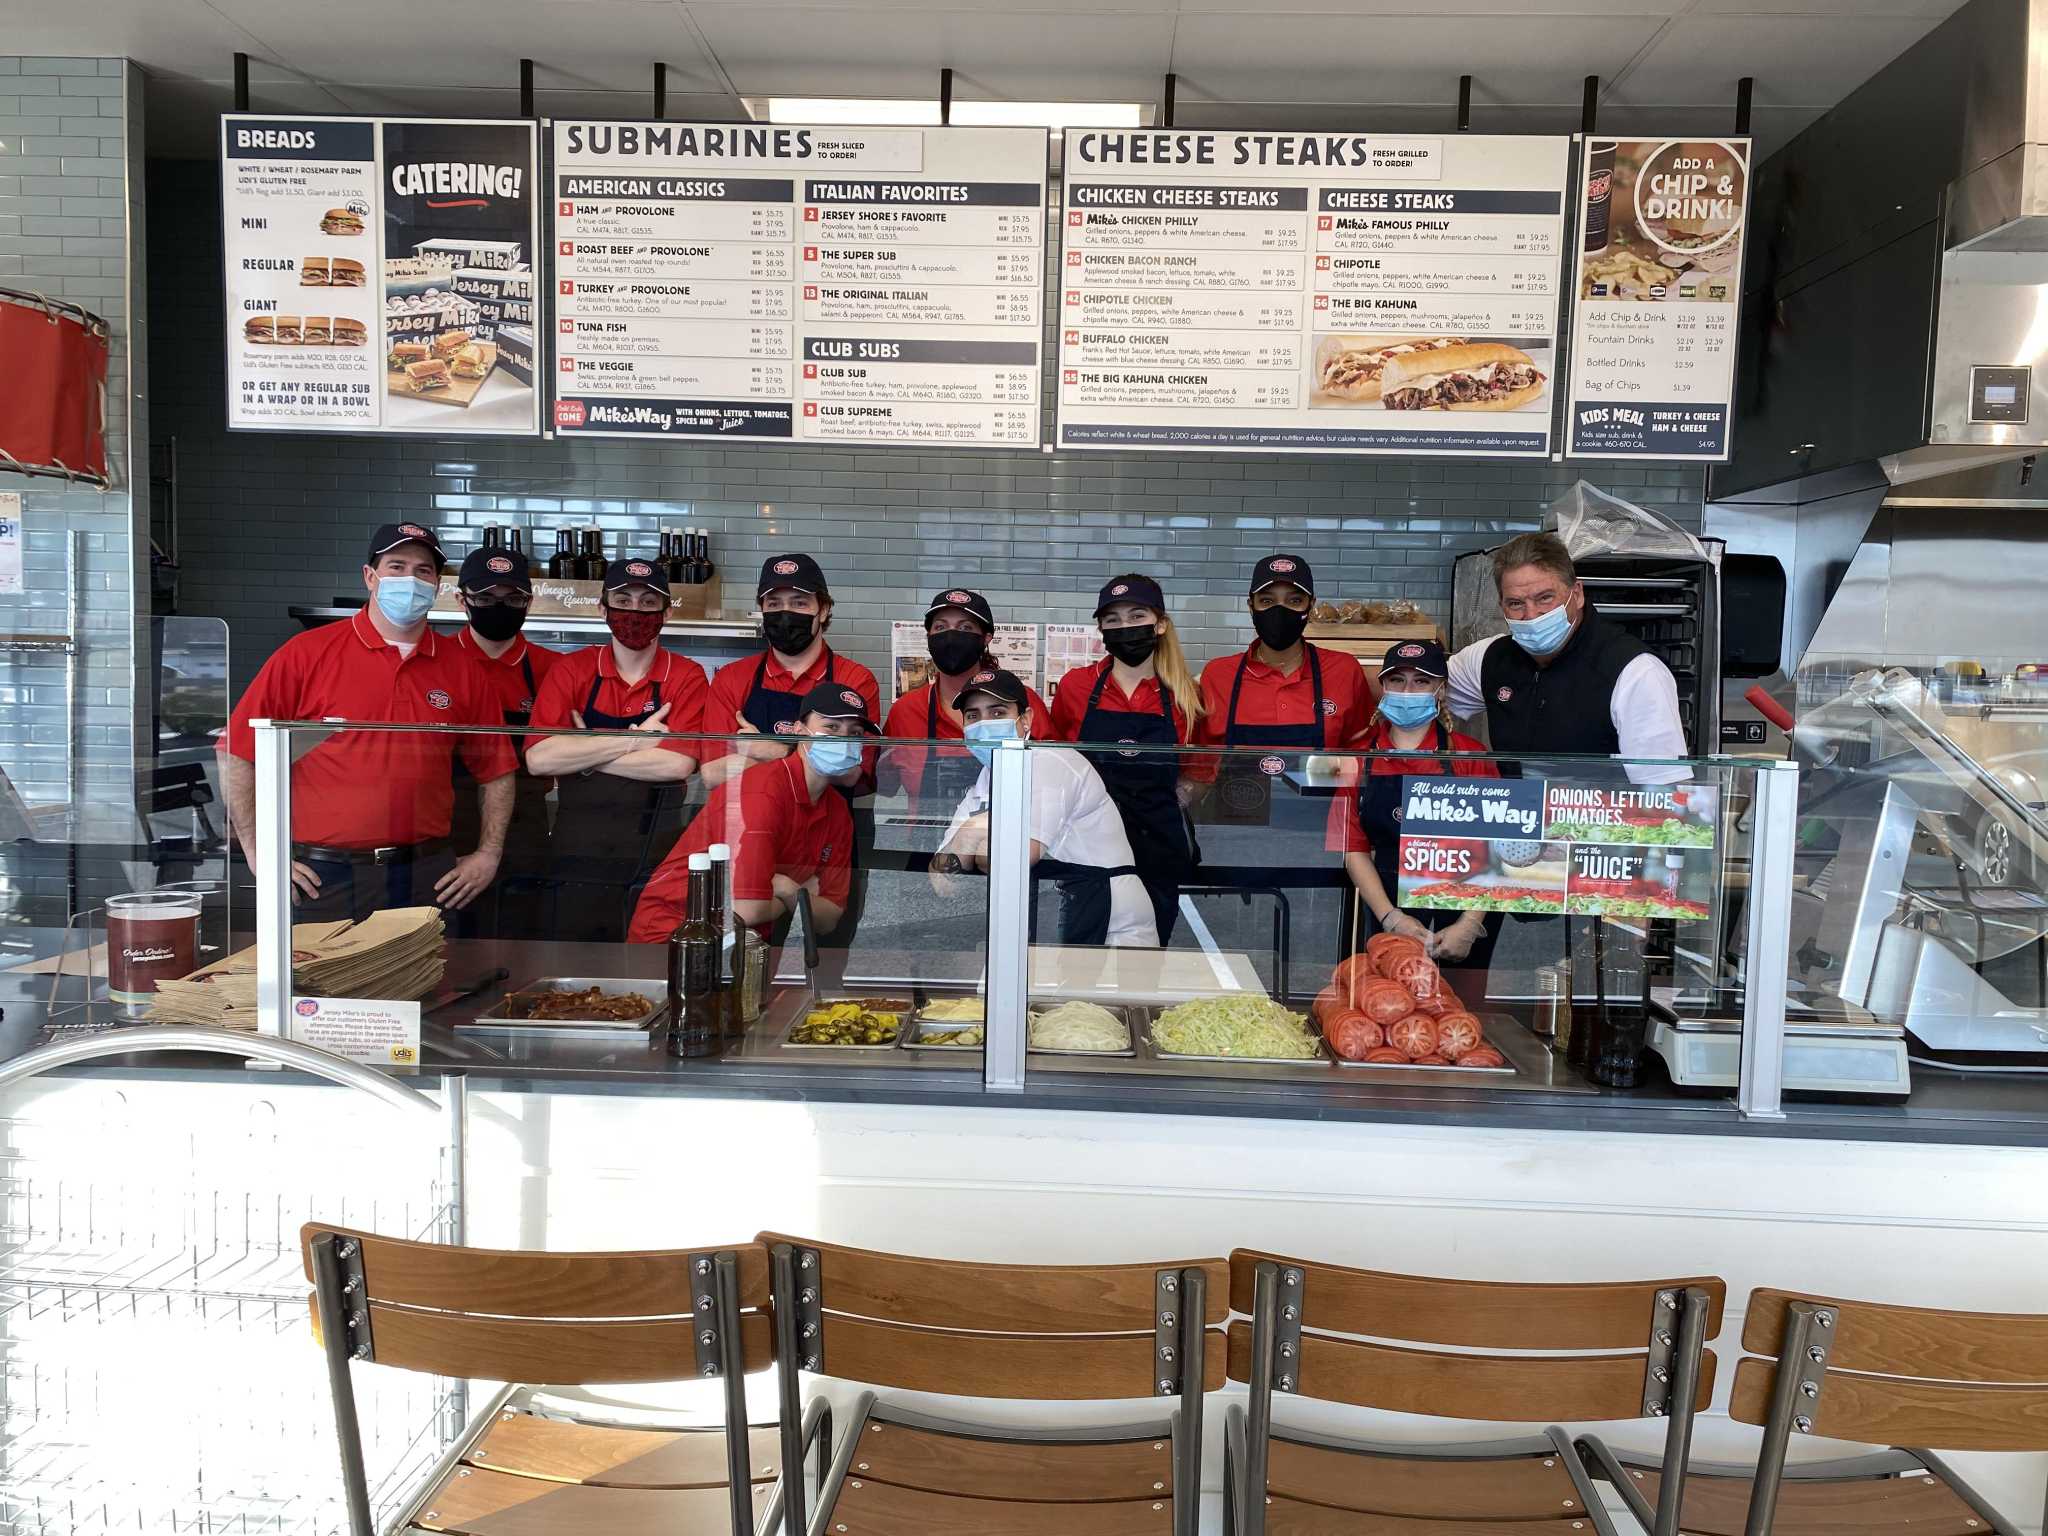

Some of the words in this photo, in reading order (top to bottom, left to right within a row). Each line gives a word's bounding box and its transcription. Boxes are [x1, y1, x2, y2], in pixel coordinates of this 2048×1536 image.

[237, 130, 316, 150] BREADS
[567, 126, 812, 158] SUBMARINES
[1079, 134, 1214, 164] CHEESE
[1234, 136, 1366, 166] STEAKS
[1673, 158, 1701, 169] ADD
[1706, 159, 1715, 169] A
[392, 162, 521, 198] CATERING!
[1651, 174, 1708, 195] CHIP
[1717, 175, 1733, 195] &
[567, 180, 650, 195] AMERICAN
[657, 182, 725, 197] CLASSICS
[813, 184, 874, 199] ITALIAN
[881, 185, 968, 201] FAVORITES
[1077, 188, 1146, 204] CHICKEN
[1153, 189, 1213, 205] CHEESE
[1219, 190, 1278, 206] STEAKS
[1327, 192, 1388, 208] CHEESE
[1395, 194, 1454, 209] STEAKS
[577, 206, 598, 215] HAM
[616, 206, 674, 216] PROVOLONE
[1648, 198, 1733, 219] DRINK!
[822, 211, 854, 220] JERSEY
[859, 212, 898, 221] SHORE'S
[902, 213, 946, 222] FAVORITE
[1087, 213, 1119, 226] Mike's
[1122, 216, 1161, 225] CHICKEN
[1165, 216, 1198, 226] PHILLY
[241, 217, 267, 229] MINI
[1336, 218, 1368, 230] Mike's
[1372, 221, 1412, 230] FAMOUS
[1416, 221, 1449, 230] PHILLY
[577, 246, 606, 254] ROAST
[610, 246, 633, 254] BEEF
[650, 246, 710, 256] PROVOLONE
[822, 251, 840, 259] THE
[843, 251, 874, 260] SUPER
[877, 252, 896, 260] SUB
[243, 259, 294, 270] REGULAR
[1085, 256, 1124, 264] CHICKEN
[1128, 256, 1161, 265] BACON
[1164, 256, 1196, 265] RANCH
[1334, 259, 1380, 269] CHIPOTLE
[577, 285, 614, 293] TURKEY
[631, 286, 690, 295] PROVOLONE
[821, 290, 839, 298] THE
[843, 290, 889, 299] ORIGINAL
[892, 291, 928, 300] ITALIAN
[244, 300, 277, 311] GIANT
[1084, 295, 1129, 304] CHIPOTLE
[1133, 296, 1172, 305] CHICKEN
[1332, 299, 1350, 308] THE
[1354, 300, 1371, 308] BIG
[1375, 300, 1417, 309] KAHUNA
[1589, 312, 1605, 321] Add
[1611, 313, 1631, 323] Chip
[1644, 313, 1666, 322] Drink
[577, 323, 603, 332] TUNA
[607, 323, 626, 332] FISH
[1083, 335, 1125, 343] BUFFALO
[1129, 335, 1168, 344] CHICKEN
[1588, 335, 1624, 344] Fountain
[1628, 335, 1654, 344] Drinks
[812, 342, 852, 357] CLUB
[860, 343, 900, 358] SUBS
[578, 362, 595, 370] THE
[599, 362, 633, 371] VEGGIE
[1587, 358, 1616, 367] Bottled
[1620, 359, 1645, 368] Drinks
[821, 369, 844, 377] CLUB
[848, 369, 866, 377] SUB
[1081, 374, 1099, 382] THE
[1103, 374, 1119, 383] BIG
[1123, 375, 1164, 384] KAHUNA
[1168, 375, 1207, 384] CHICKEN
[242, 381, 256, 391] OR
[259, 382, 277, 392] GET
[281, 382, 300, 392] ANY
[304, 383, 348, 393] REGULAR
[352, 383, 370, 393] SUB
[1586, 380, 1602, 391] Bag
[1605, 380, 1615, 389] of
[1617, 381, 1640, 392] Chips
[243, 394, 253, 403] IN
[257, 394, 264, 404] A
[268, 394, 297, 404] WRAP
[301, 395, 314, 405] OR
[318, 395, 328, 405] IN
[332, 396, 338, 405] A
[342, 396, 369, 406] BOWL
[558, 413, 581, 422] COME
[695, 409, 722, 418] ONIONS,
[724, 410, 752, 418] LETTUCE,
[754, 411, 789, 419] TOMATOES,
[821, 407, 844, 415] CLUB
[848, 407, 892, 417] SUPREME
[1580, 408, 1608, 426] KIDS
[1613, 408, 1645, 427] MEAL
[1653, 412, 1682, 420] TURKEY
[1693, 413, 1720, 421] CHEESE
[635, 409, 671, 431] Way
[534, 582, 575, 601] Vinegar
[1411, 782, 1430, 796] All
[1432, 784, 1455, 794] cold
[1457, 784, 1480, 796] subs
[1482, 788, 1510, 797] come
[1550, 788, 1605, 808] ONIONS,
[1406, 797, 1479, 822] Mike's
[1404, 848, 1470, 872] SPICES
